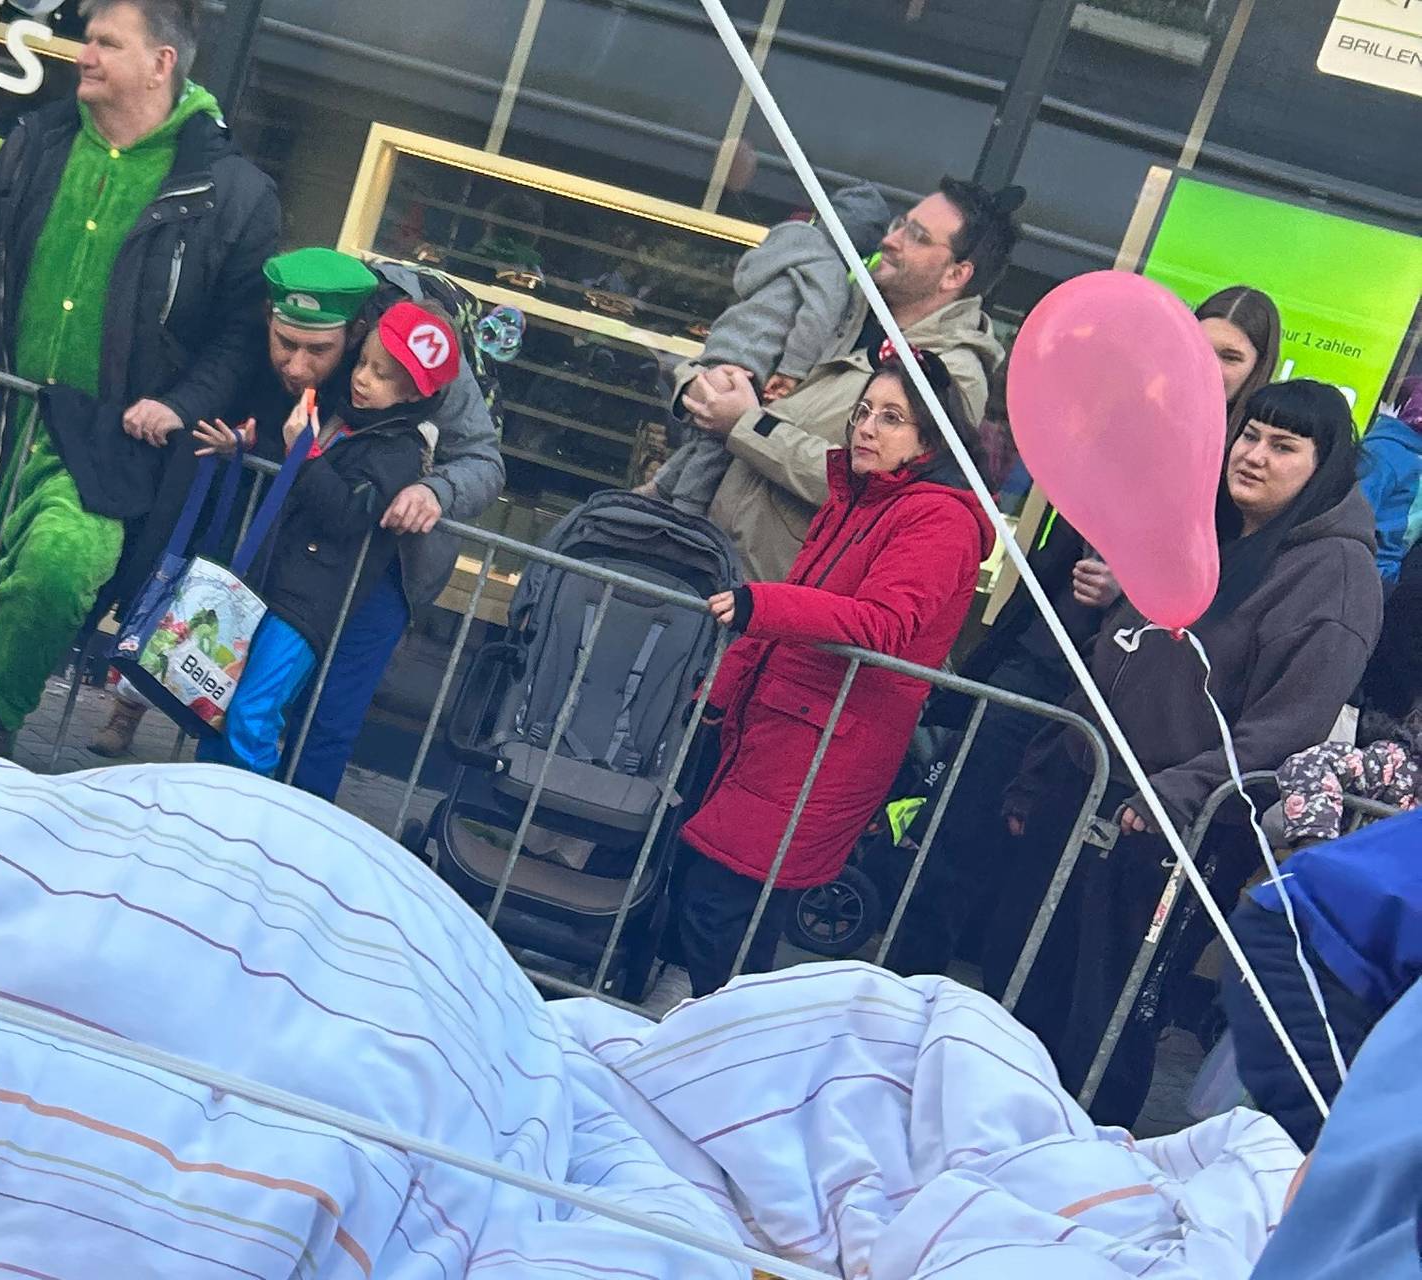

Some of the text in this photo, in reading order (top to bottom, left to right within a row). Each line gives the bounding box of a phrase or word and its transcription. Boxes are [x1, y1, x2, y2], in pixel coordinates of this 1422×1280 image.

[412, 329, 443, 365] M
[1302, 332, 1312, 347] 1
[1314, 338, 1362, 360] zahlen
[180, 653, 226, 701] Balea
